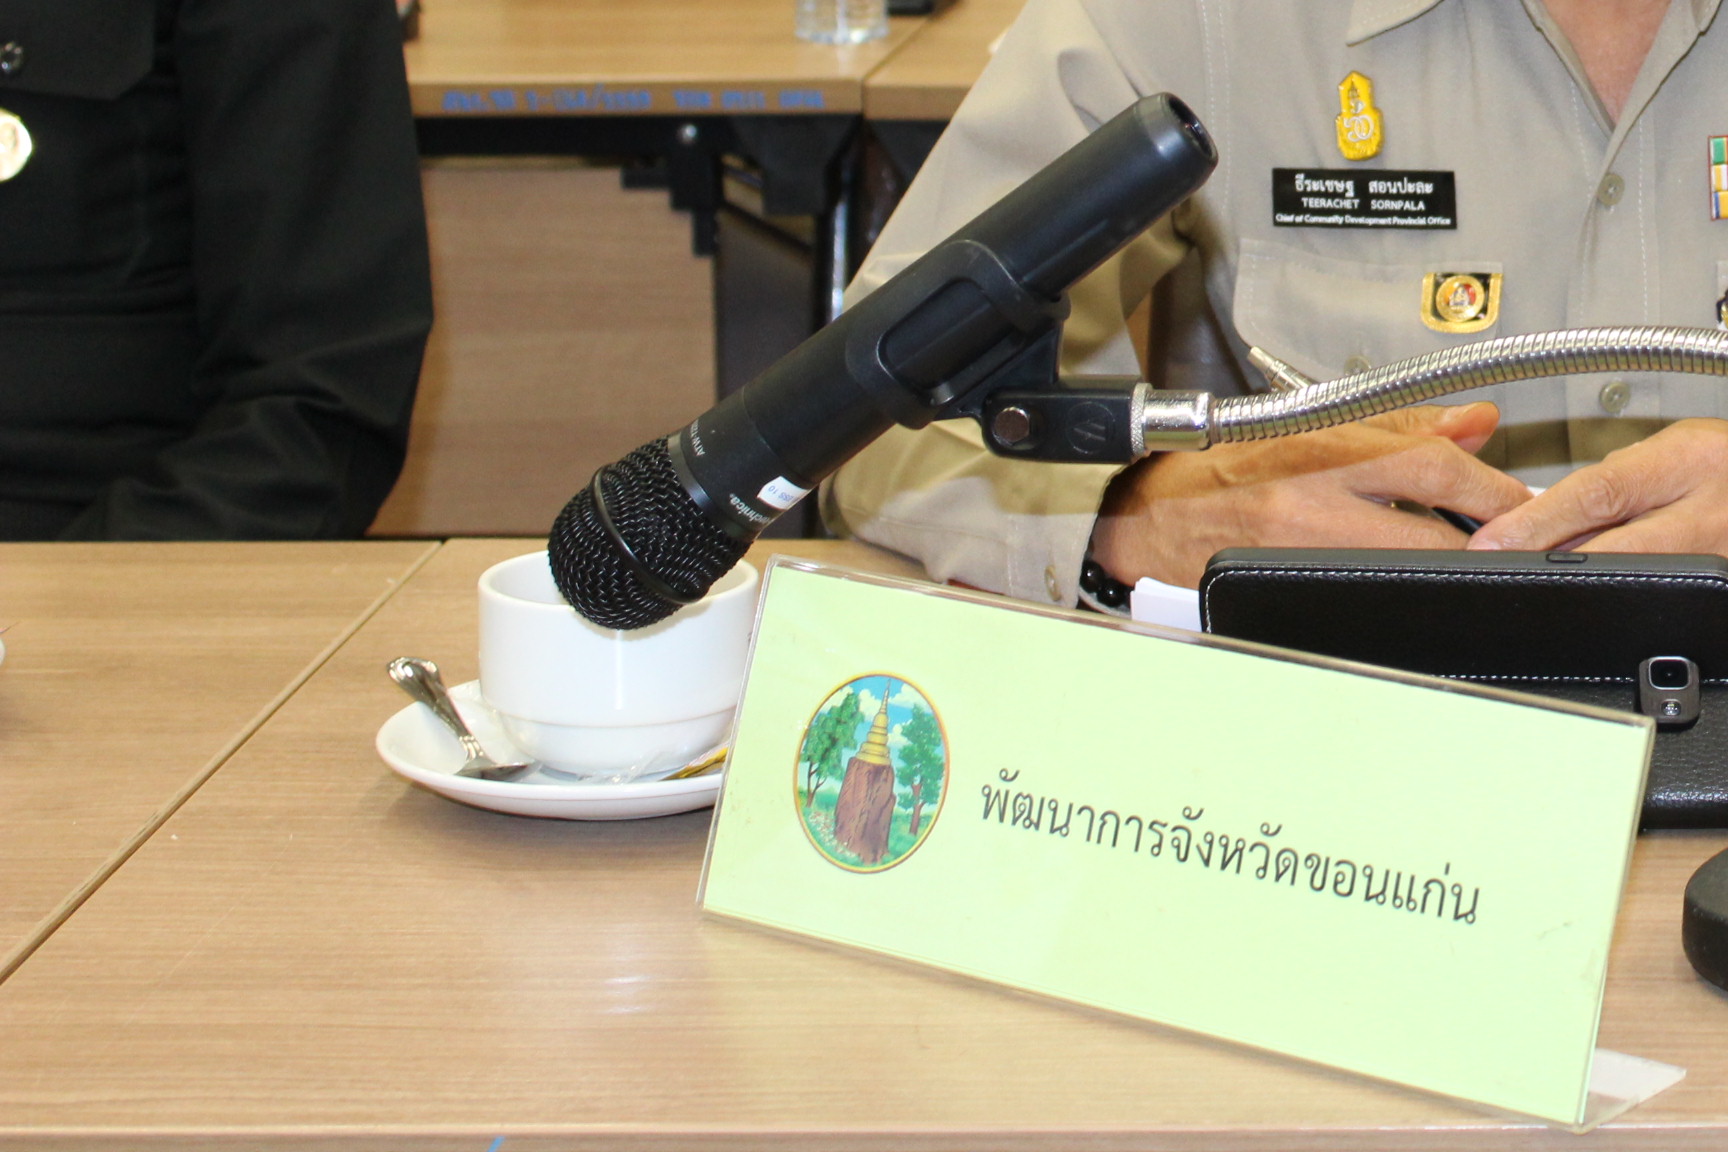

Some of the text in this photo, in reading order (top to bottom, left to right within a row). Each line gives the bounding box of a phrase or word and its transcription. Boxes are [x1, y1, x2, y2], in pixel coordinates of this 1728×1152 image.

[1301, 197, 1426, 211] TEERACHET SORNPALA
[1304, 214, 1344, 225] Community
[1344, 215, 1392, 226] Development
[1427, 216, 1452, 226] Office
[981, 768, 1481, 924] พัฒนาการจังหวัดขอนแก่น
